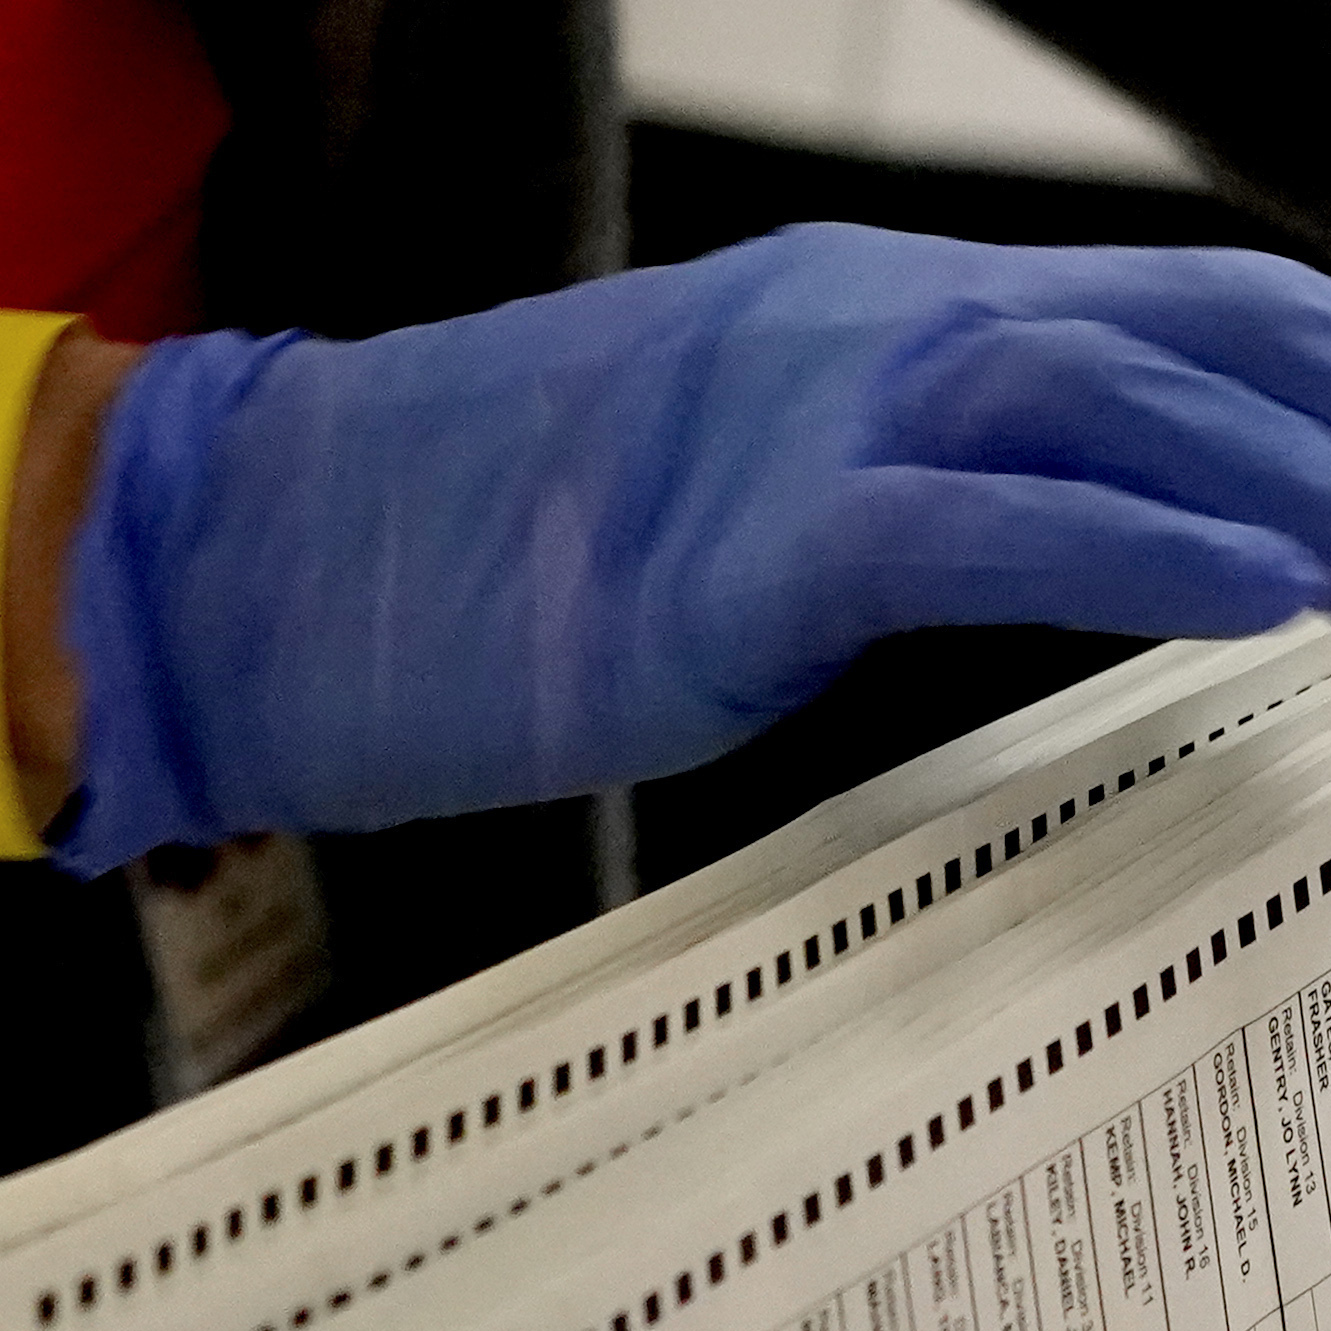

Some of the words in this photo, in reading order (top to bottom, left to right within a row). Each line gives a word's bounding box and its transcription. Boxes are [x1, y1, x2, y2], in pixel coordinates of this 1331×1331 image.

[1267, 1015, 1289, 1113] GENTRY,
[1307, 988, 1330, 1093] FRASHER
[1224, 1041, 1241, 1109] Retain:
[1236, 1125, 1253, 1203] Division
[1247, 1206, 1259, 1232] 15
[1280, 1117, 1294, 1144] JO
[1281, 1004, 1297, 1076] Retain:
[1292, 1090, 1311, 1167] Division
[1304, 1170, 1317, 1196] 13
[1104, 1123, 1123, 1197] KEMP,
[1162, 1087, 1184, 1190] HANNAH,
[1175, 1194, 1193, 1253] JOHN
[1184, 1255, 1196, 1281] R.
[1175, 1078, 1193, 1150] Retain:
[1186, 1163, 1205, 1241] Division
[1198, 1244, 1211, 1270] 16
[1212, 1051, 1234, 1156] GORDON,
[1226, 1157, 1247, 1257] MICHAEL
[1240, 1258, 1251, 1284] D.
[1285, 1148, 1303, 1208] LYNN
[1113, 1198, 1136, 1298] MICHAEL
[1130, 1200, 1148, 1279] Division
[1141, 1282, 1154, 1306] 11
